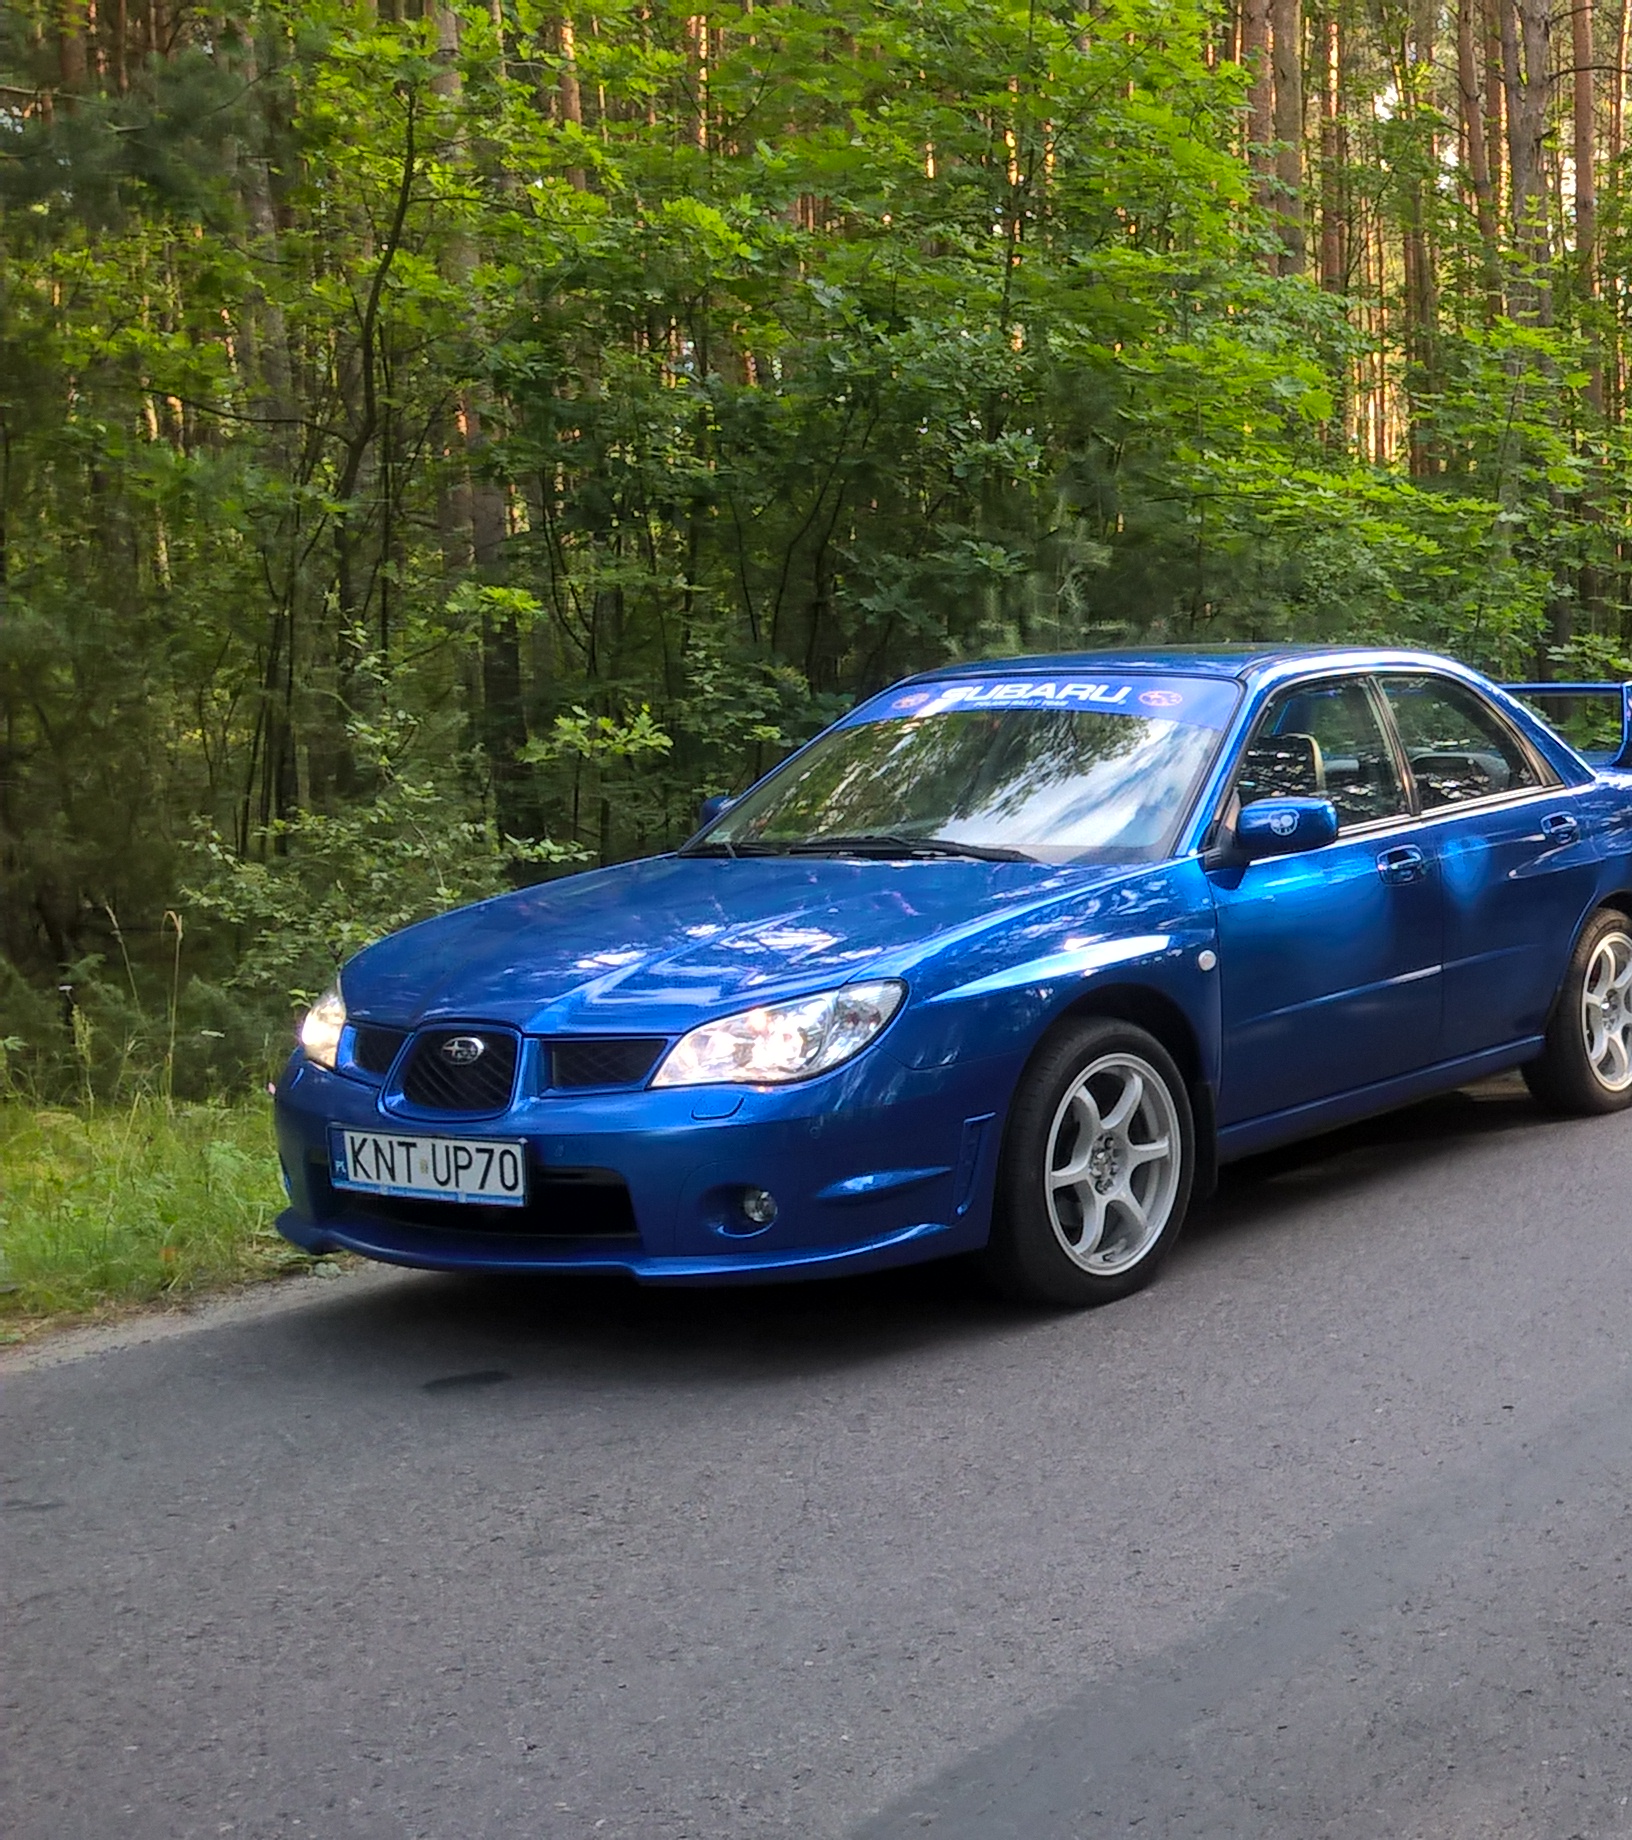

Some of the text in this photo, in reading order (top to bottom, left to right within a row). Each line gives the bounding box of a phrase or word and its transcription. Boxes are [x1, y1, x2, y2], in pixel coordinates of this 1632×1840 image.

[941, 682, 1133, 703] SUBARU
[350, 1136, 519, 1191] KNT UP70
